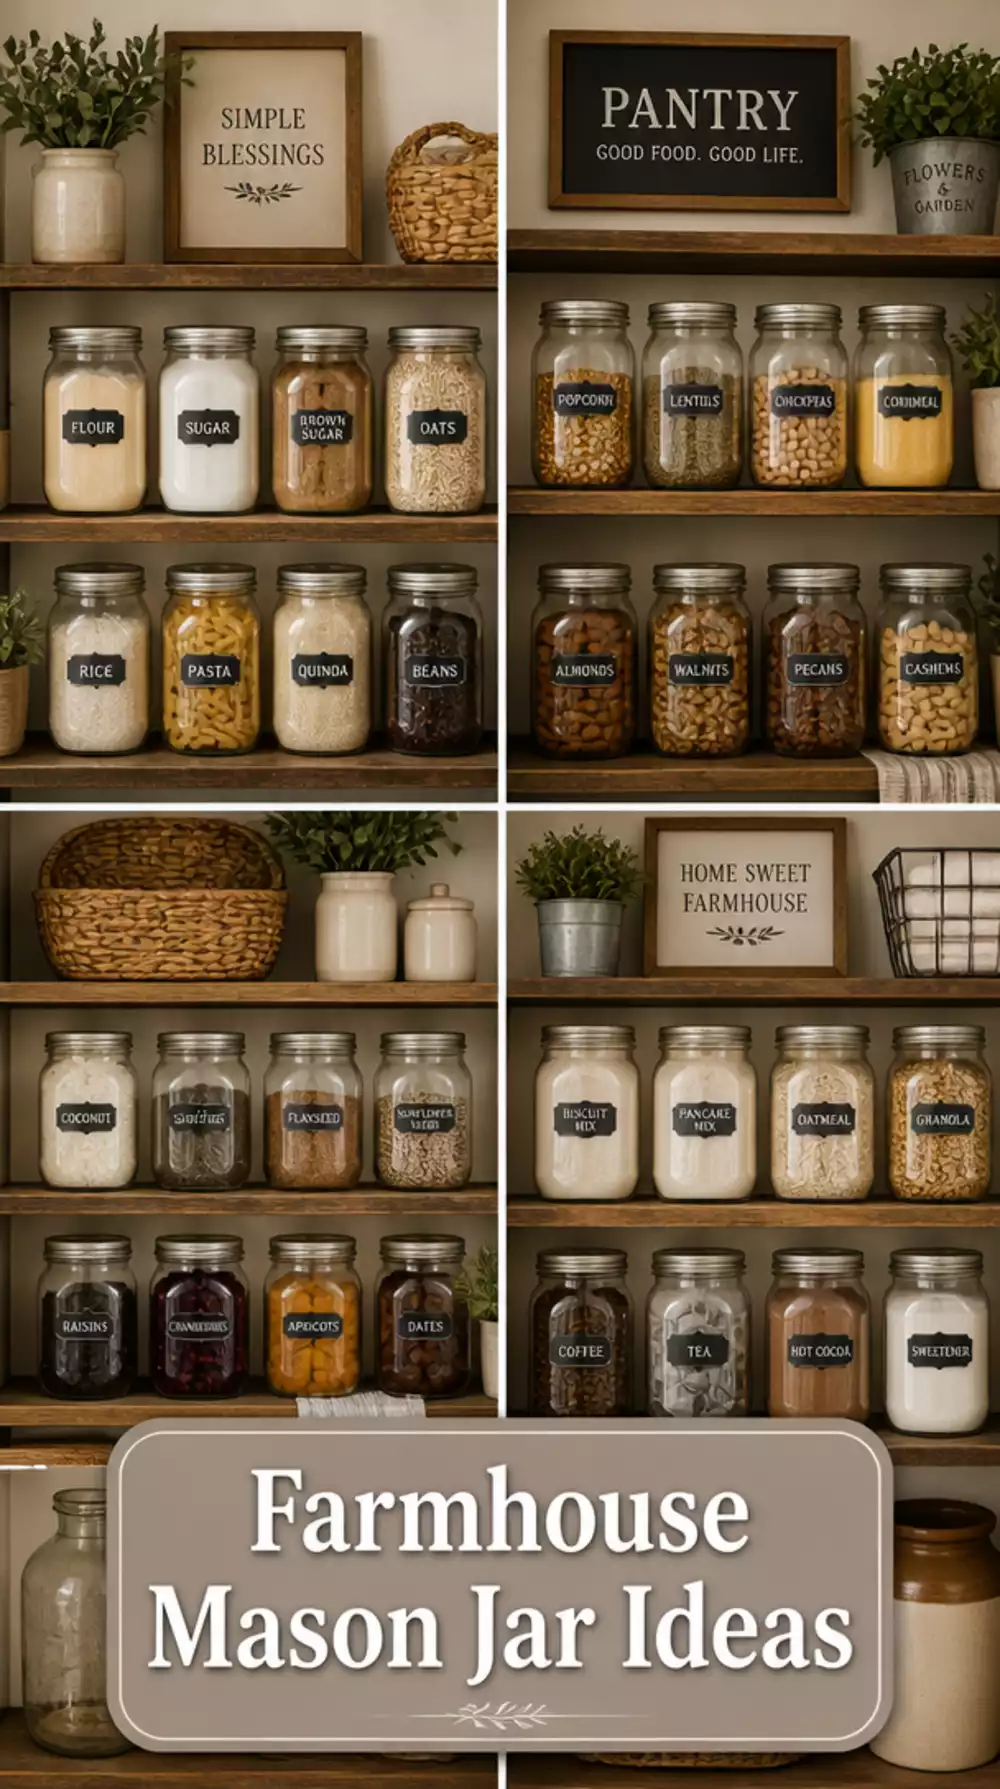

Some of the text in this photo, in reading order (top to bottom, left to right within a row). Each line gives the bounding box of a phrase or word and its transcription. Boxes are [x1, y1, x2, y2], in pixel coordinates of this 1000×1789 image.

[601, 86, 800, 132] PANTRY
[221, 107, 305, 130] SIMPLE
[202, 142, 325, 166] BLESSINGS
[596, 144, 804, 164] GOOD FOOD. GOOD LIFE.
[903, 162, 986, 187] FLOWERS
[558, 393, 615, 407] POPCORN
[71, 421, 115, 435] FLOUR
[185, 421, 231, 435] SUGAR
[301, 427, 344, 441] SUGAR
[420, 421, 456, 435] OATS
[79, 664, 113, 679] RICE
[187, 664, 231, 678] PASTA
[412, 664, 459, 678] BEANS
[555, 663, 615, 678] ALMONDS
[794, 662, 844, 677] PECANS
[680, 862, 812, 883] HOME SWEET
[683, 892, 809, 913] FARMHOUSE
[60, 1112, 112, 1124] COCONUT
[797, 1113, 852, 1126] OATMEAL
[915, 1113, 970, 1126] GRANOLA
[574, 1120, 597, 1132] MIX
[62, 1320, 109, 1333] RAISINS
[407, 1321, 444, 1333] DATES
[558, 1345, 605, 1358] COFFEE
[687, 1345, 712, 1358] TEA
[790, 1345, 813, 1358] HOT
